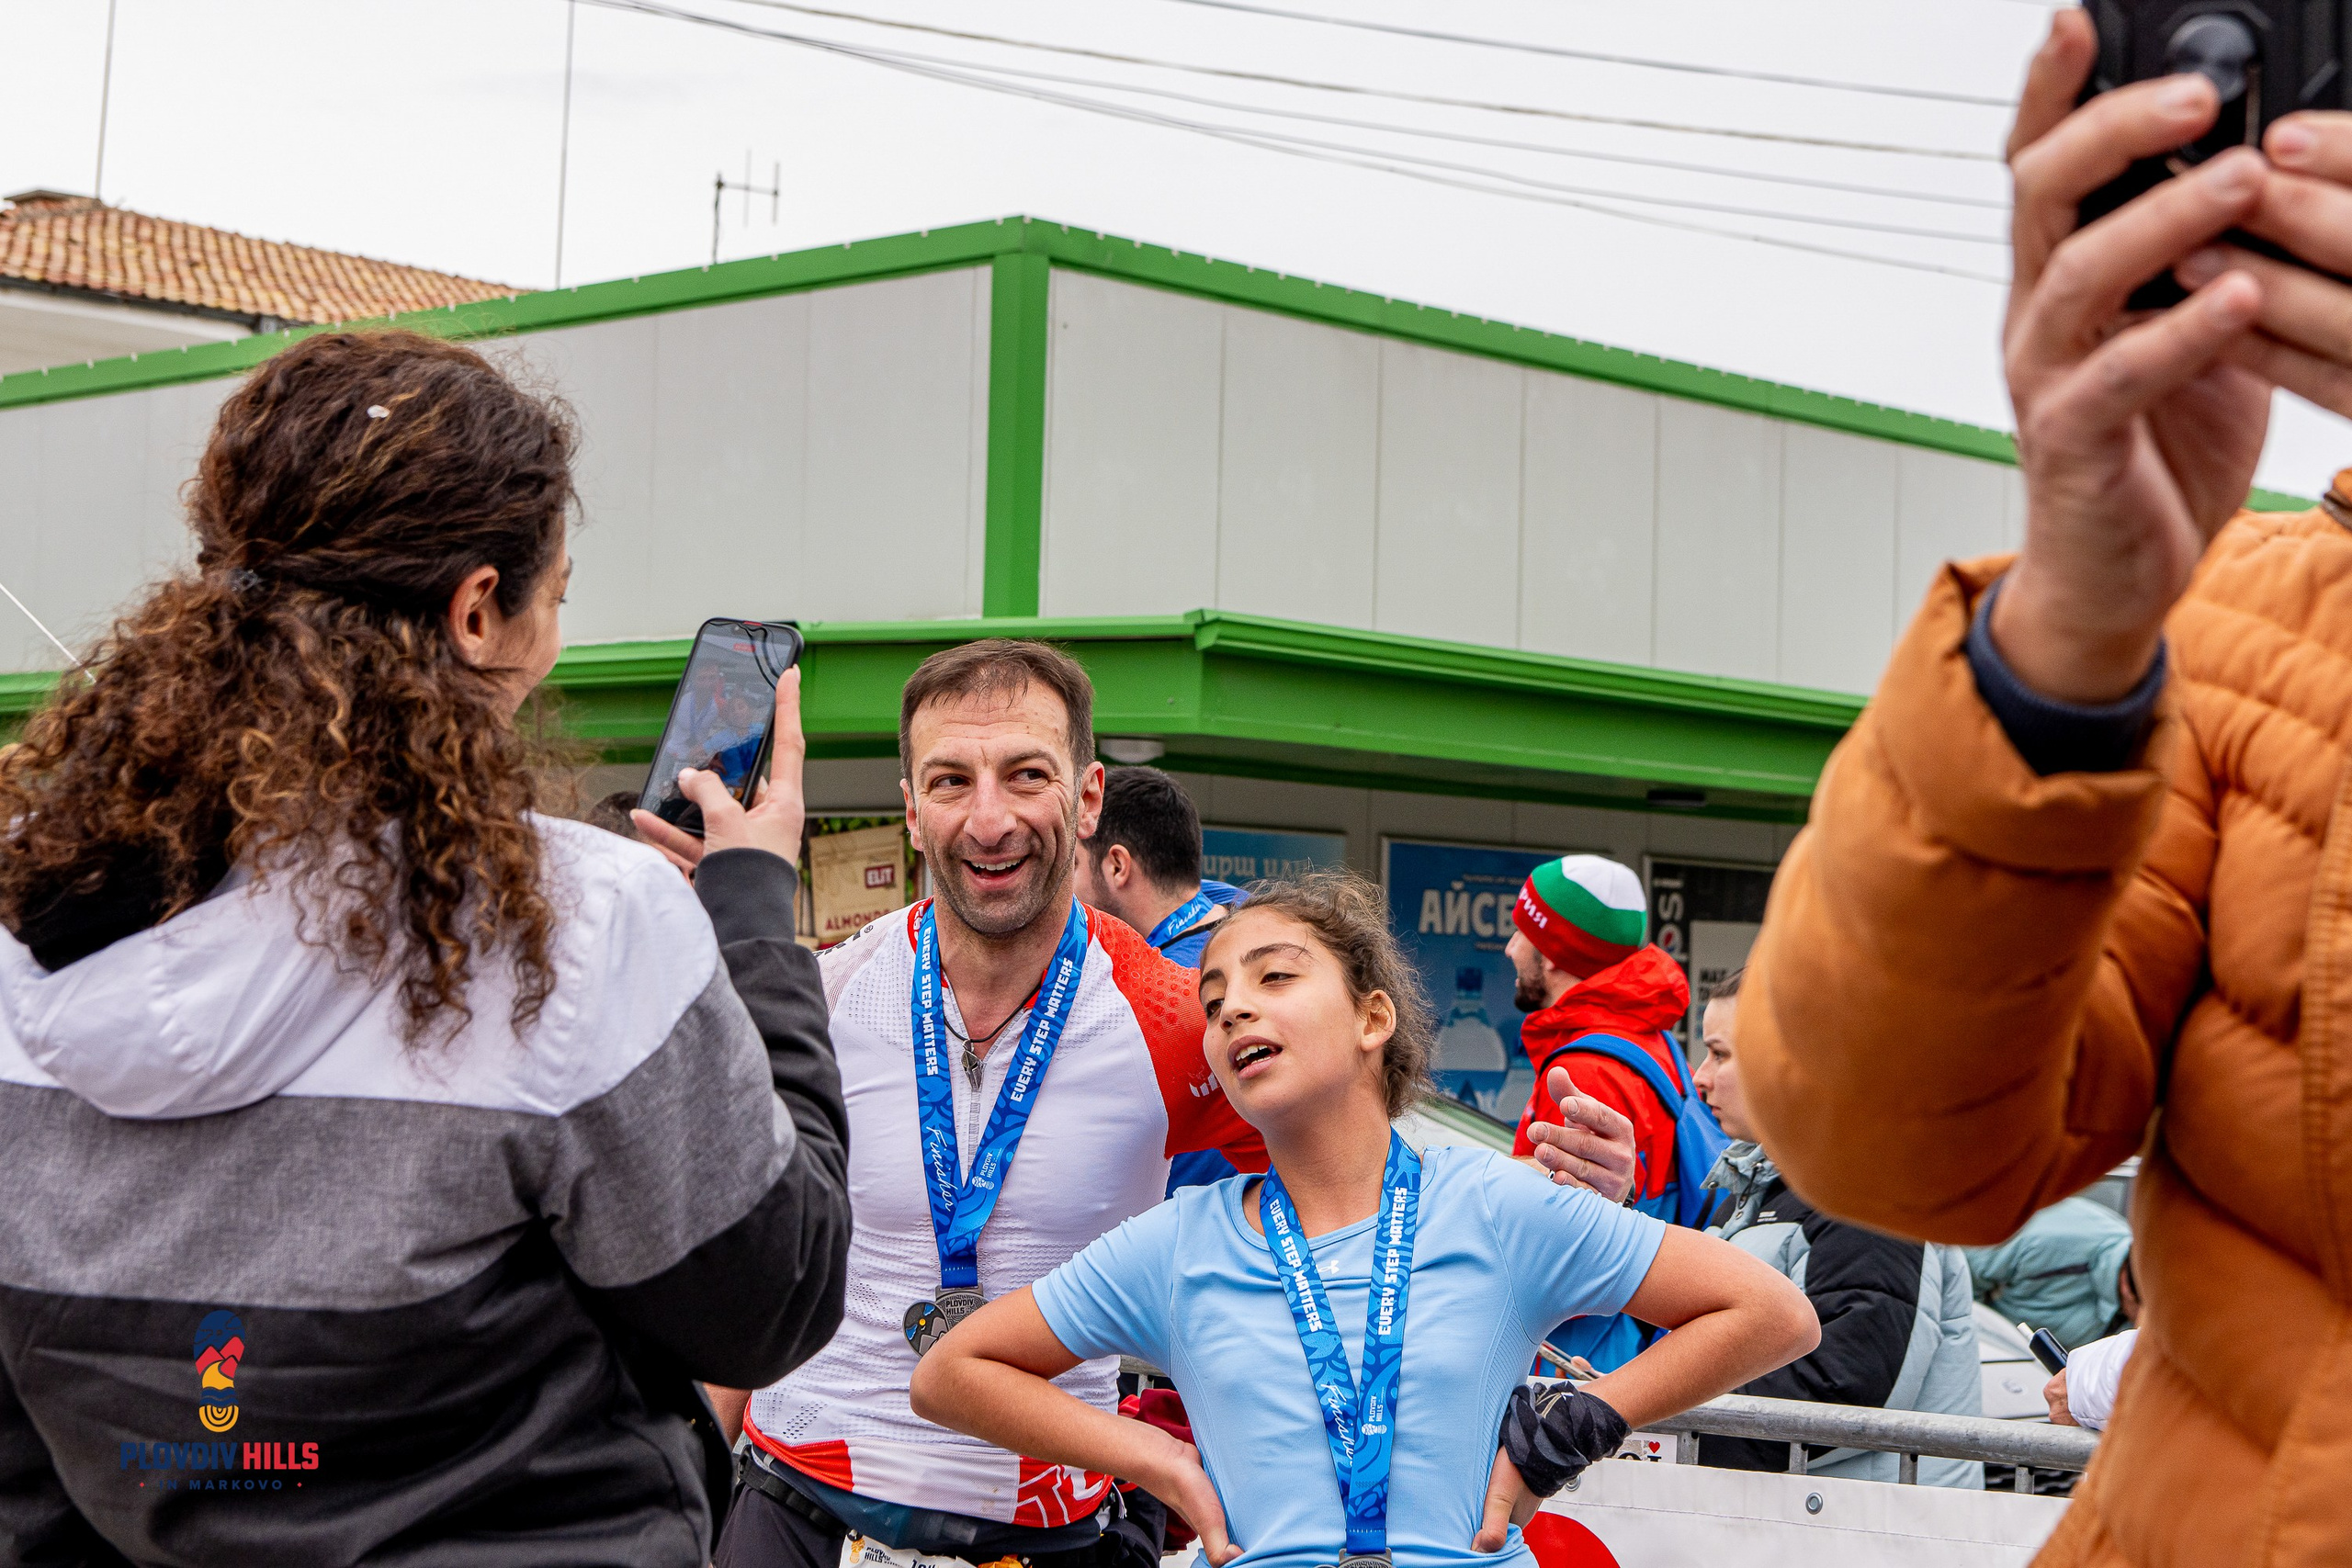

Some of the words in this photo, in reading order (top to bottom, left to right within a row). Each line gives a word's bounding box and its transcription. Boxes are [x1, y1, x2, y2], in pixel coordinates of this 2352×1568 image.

[866, 867, 893, 886] ELIT
[921, 973, 933, 1009] STEP
[1029, 1019, 1051, 1055] STEP
[1044, 957, 1074, 1019] MATTERS
[922, 1012, 939, 1077] MATTERS
[926, 1126, 958, 1213] Finisher
[979, 1152, 994, 1177] PLOVDIV
[986, 1162, 997, 1179] HILLS
[1388, 1187, 1408, 1246] MATTERS
[1384, 1248, 1401, 1284] STEP
[1281, 1235, 1303, 1269] STEP
[1293, 1269, 1323, 1333] MATTERS
[945, 1299, 975, 1308] PLOVDIV
[945, 1307, 965, 1315] HILLS
[1368, 1395, 1377, 1422] PLOVDIV
[1375, 1404, 1384, 1422] HILLS
